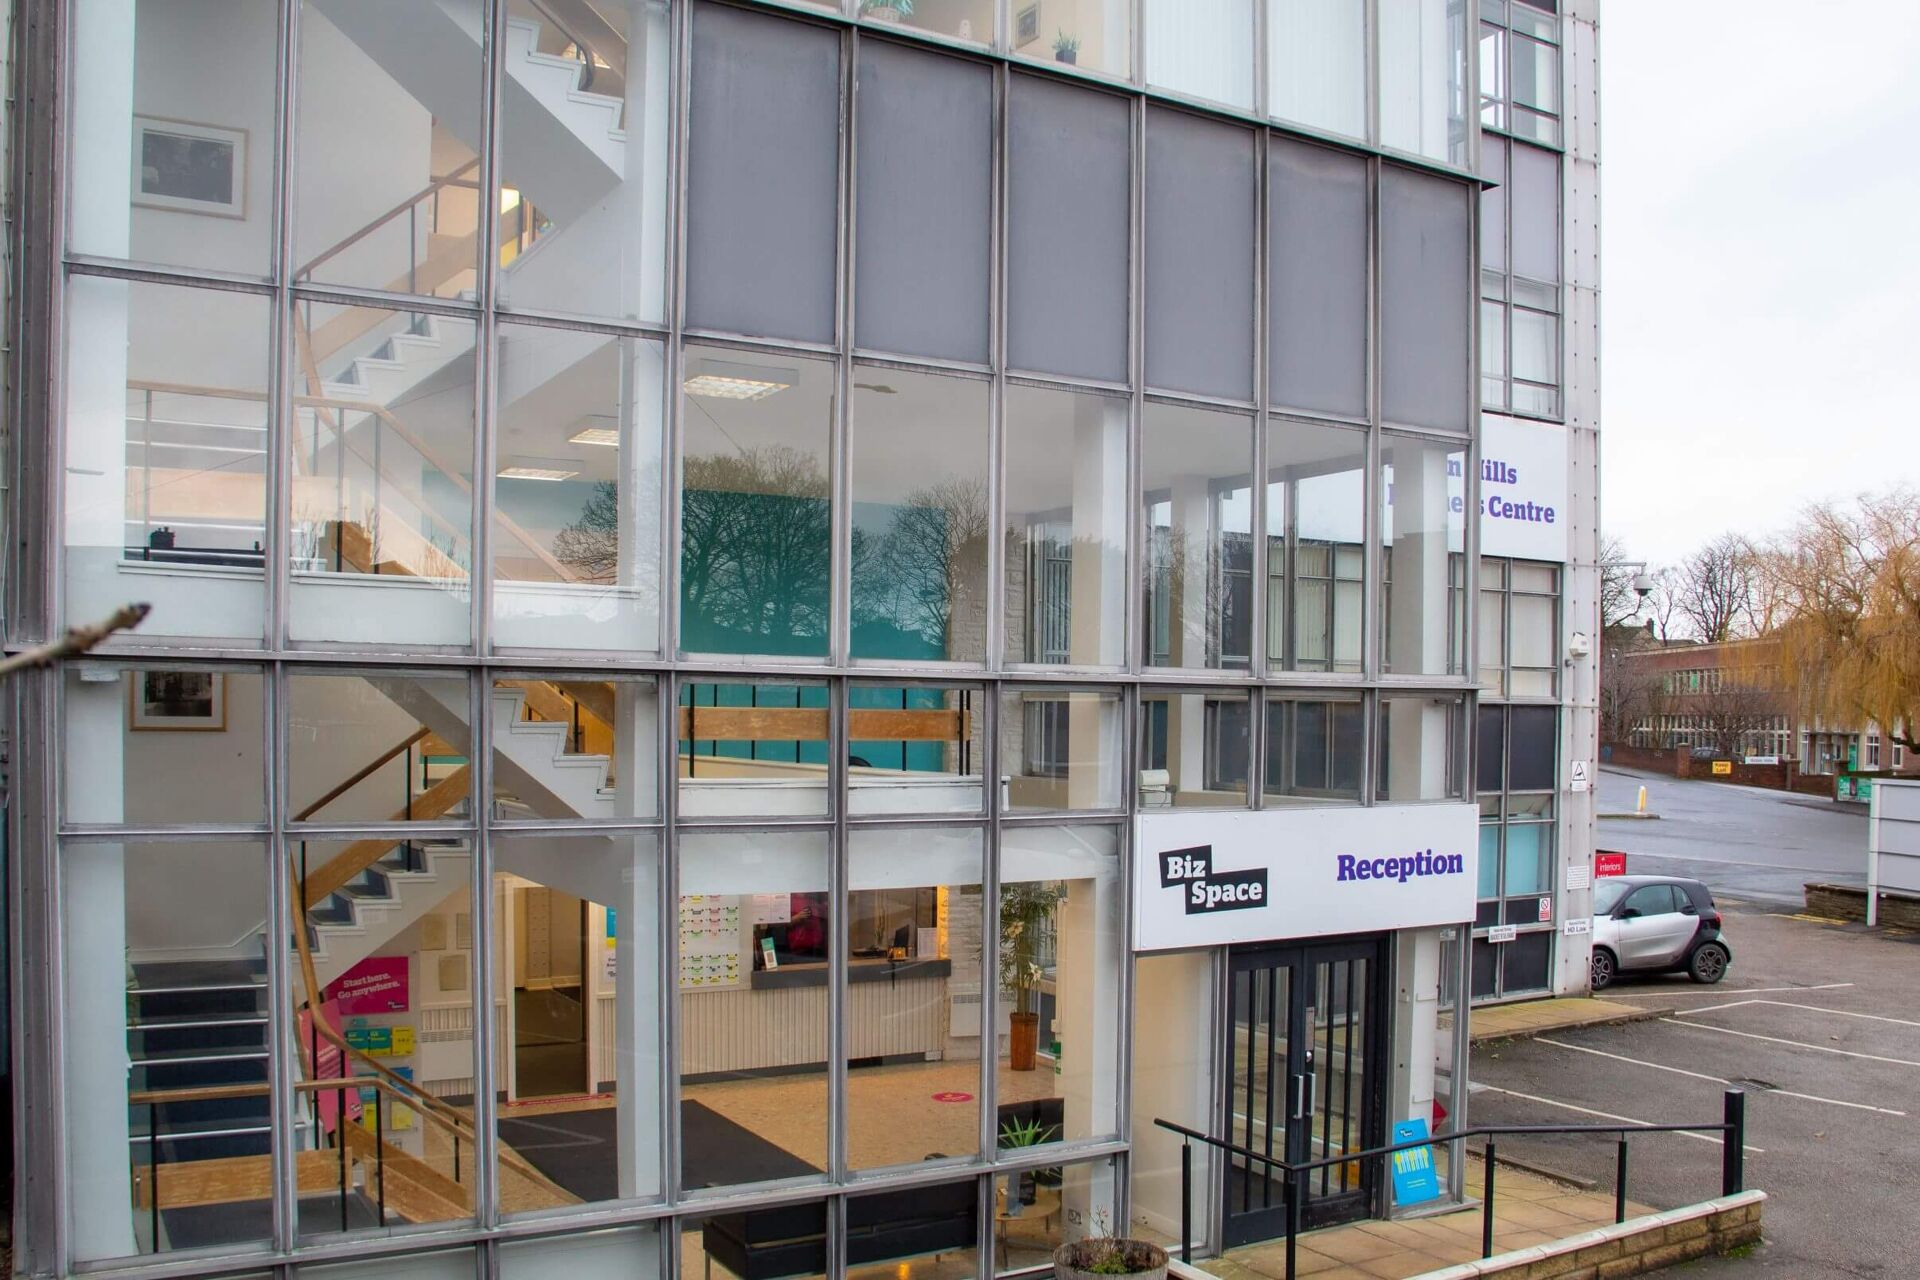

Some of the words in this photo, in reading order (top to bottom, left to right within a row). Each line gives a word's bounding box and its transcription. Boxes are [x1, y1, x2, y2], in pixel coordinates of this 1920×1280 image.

[1488, 496, 1555, 523] Centre
[1167, 854, 1206, 879] Biz
[1337, 849, 1463, 883] Reception
[1191, 880, 1263, 908] Space
[337, 991, 351, 999] Go
[352, 981, 400, 997] anywhere.
[343, 977, 366, 988] Start
[367, 973, 391, 983] here.
